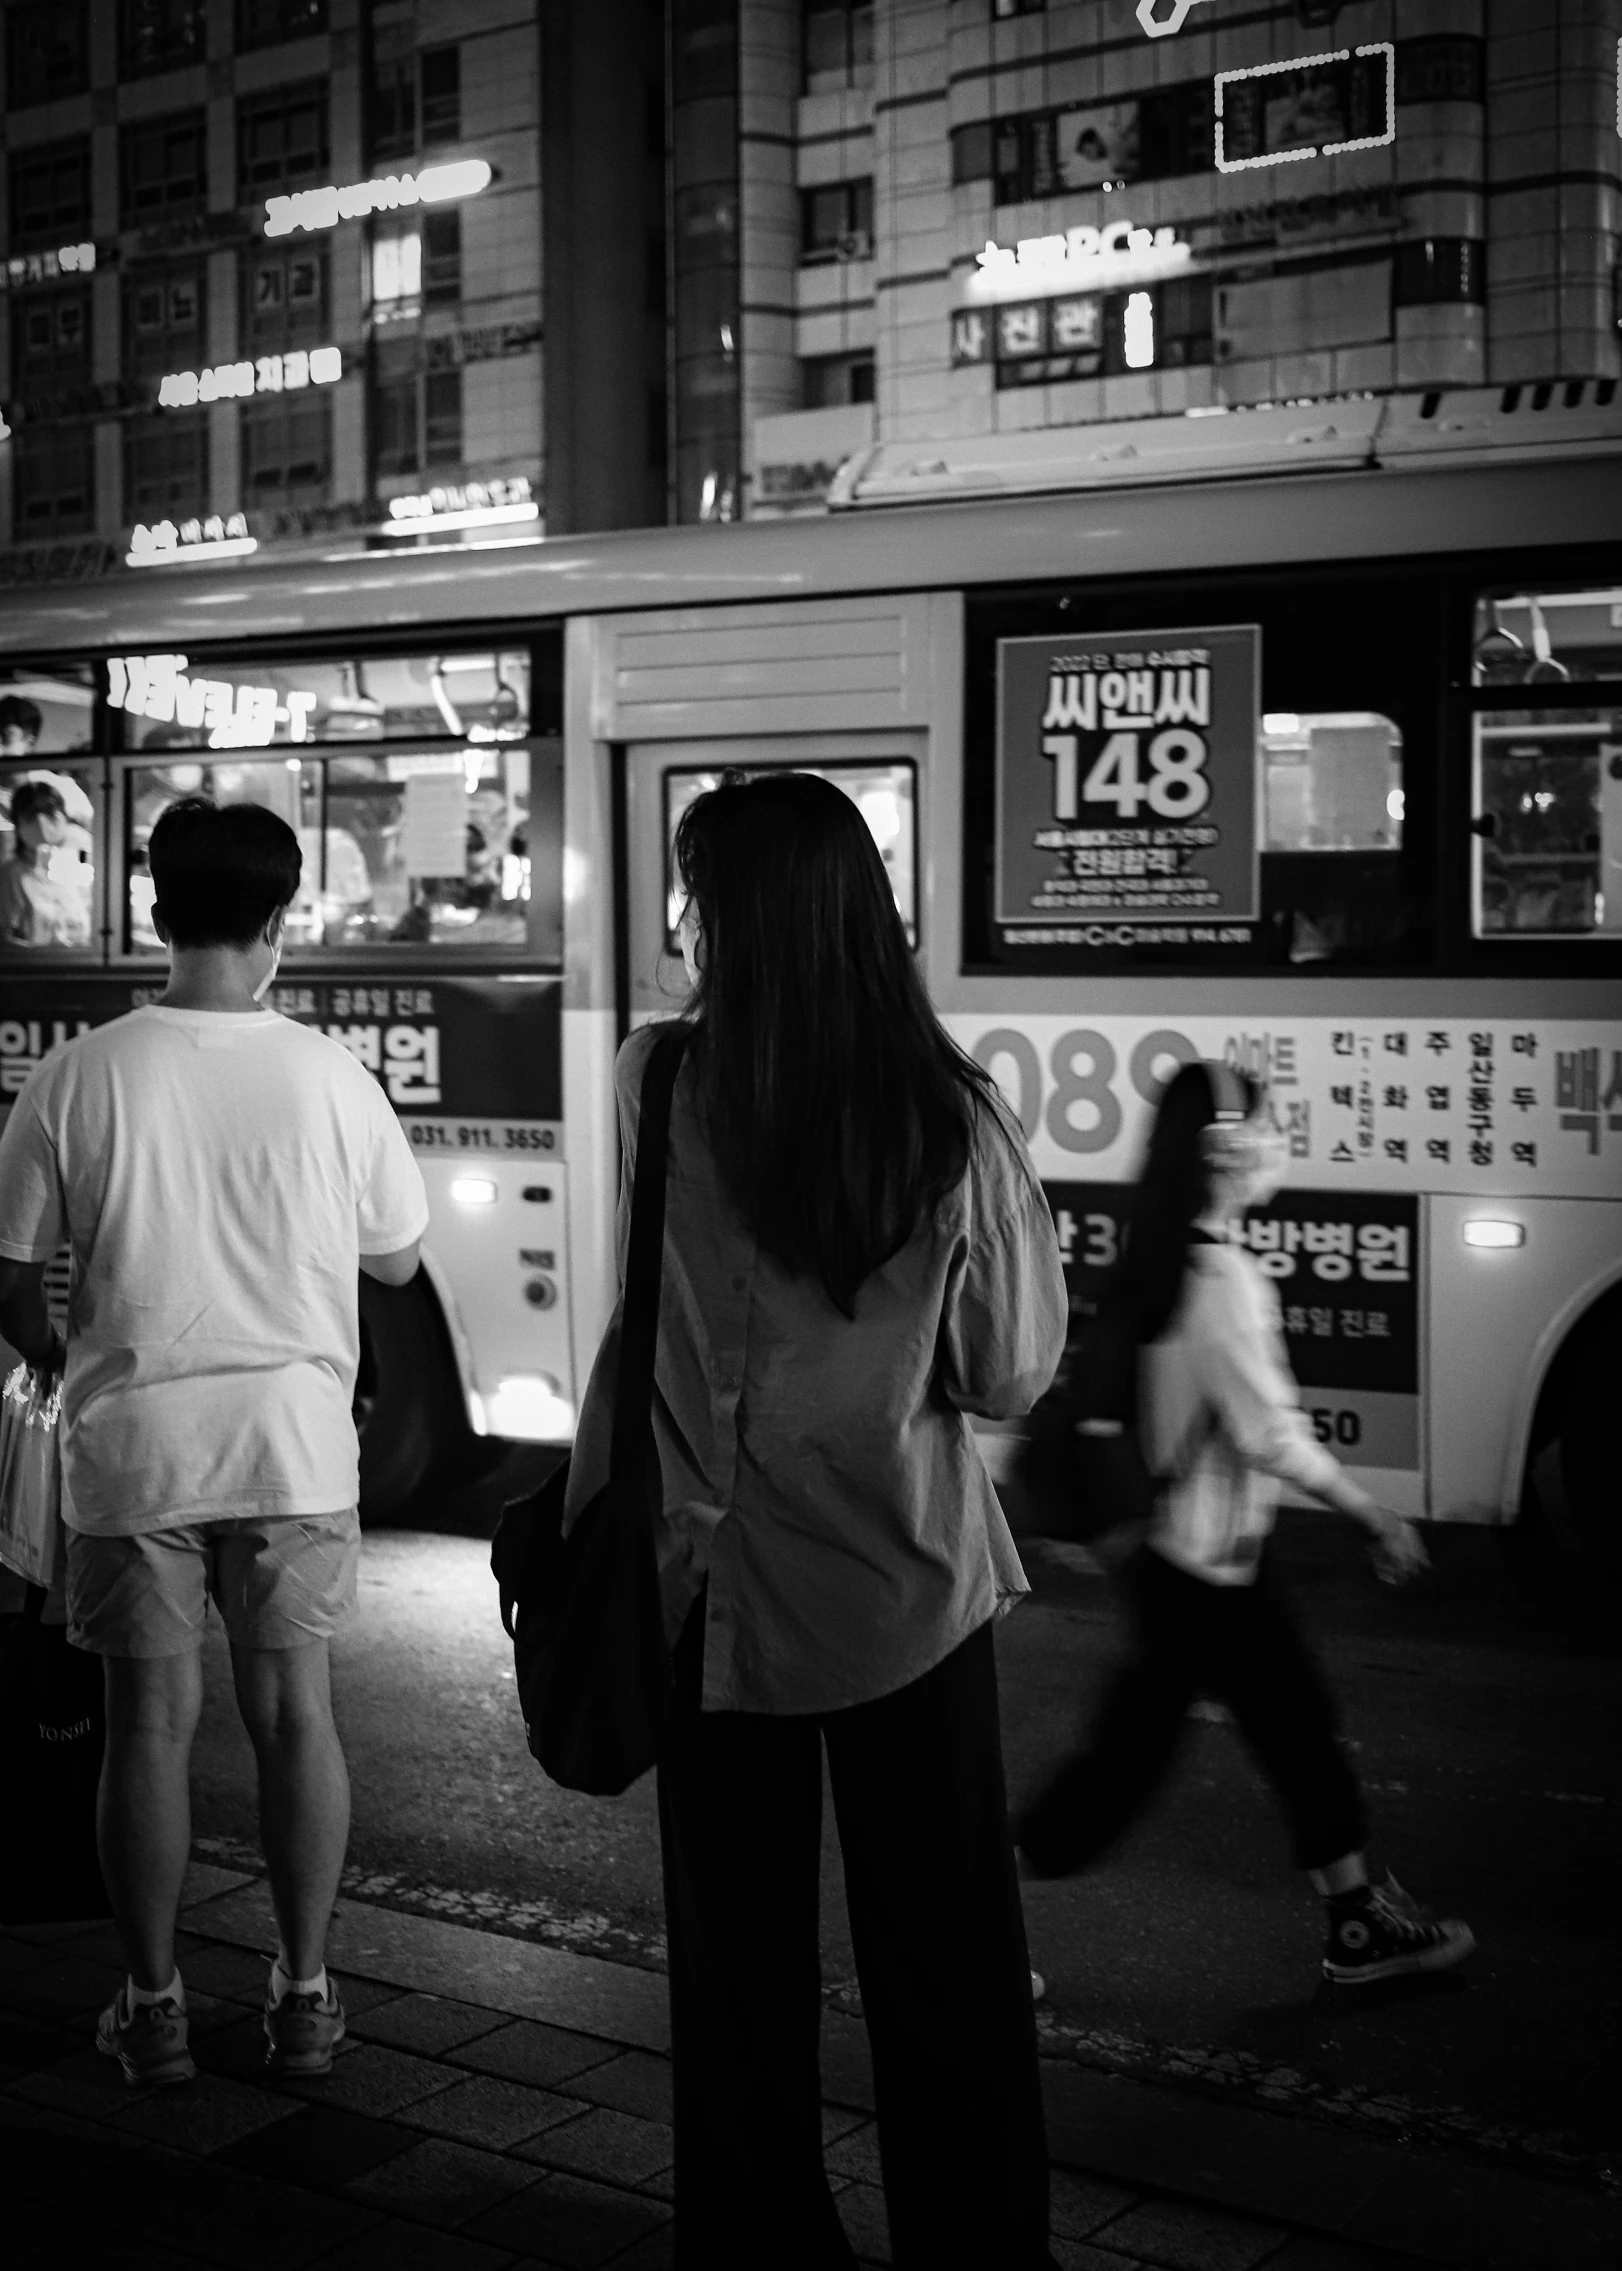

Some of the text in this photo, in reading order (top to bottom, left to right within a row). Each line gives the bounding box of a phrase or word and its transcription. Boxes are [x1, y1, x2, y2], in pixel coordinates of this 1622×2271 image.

[1042, 667, 1210, 731] 씨앤씨
[1043, 728, 1210, 820] 148
[1383, 1030, 1409, 1165] 대화역
[1424, 1030, 1452, 1164] 주엽역
[1509, 1031, 1539, 1169] 마두역
[1284, 1305, 1334, 1338] 휴일
[1310, 1407, 1361, 1446] 50
